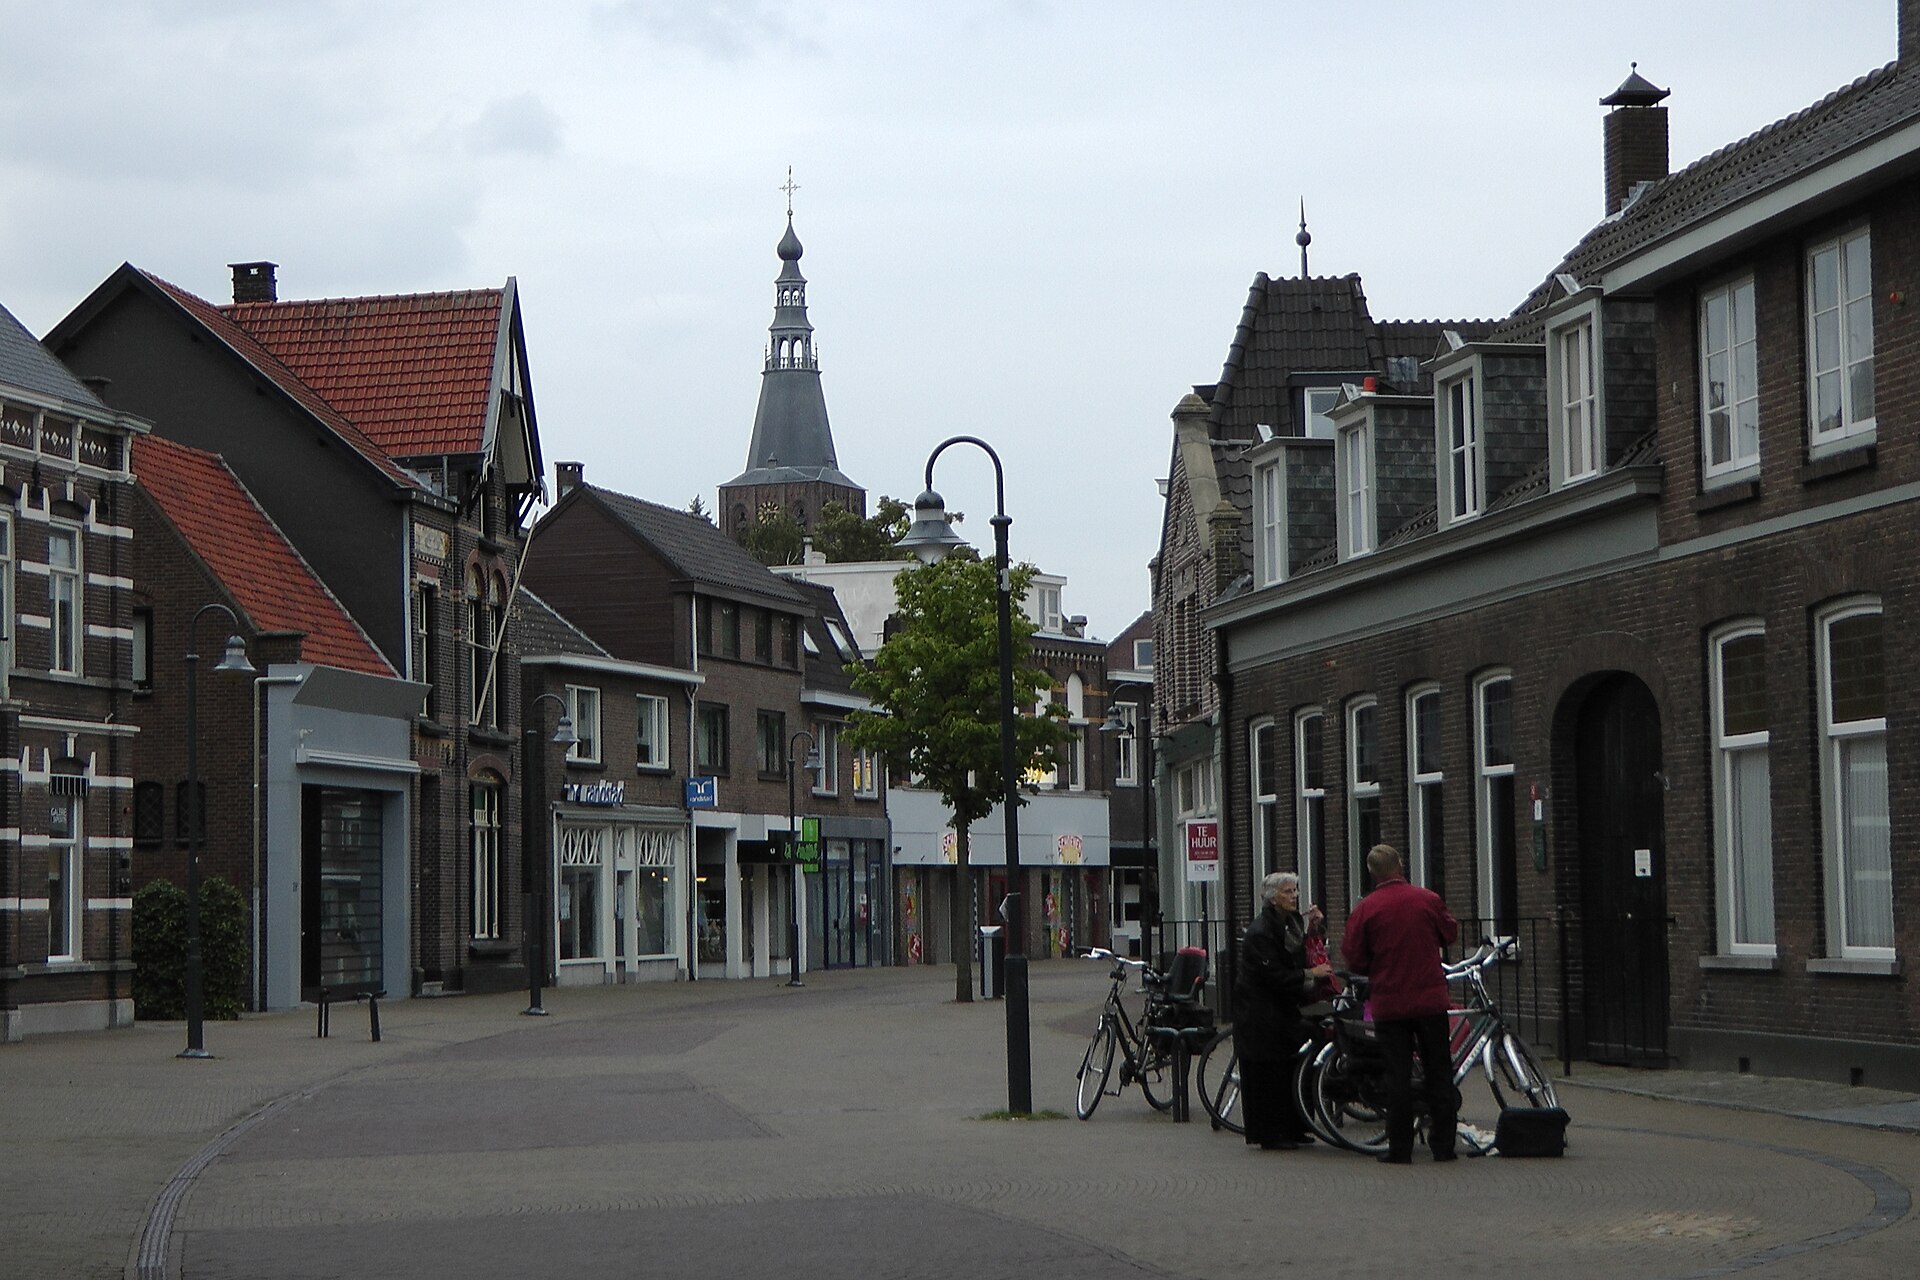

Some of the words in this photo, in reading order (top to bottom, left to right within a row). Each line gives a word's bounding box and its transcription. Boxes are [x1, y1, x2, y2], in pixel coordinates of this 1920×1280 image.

[580, 779, 624, 803] randstad
[1197, 826, 1208, 837] TE
[1191, 837, 1216, 848] HUUR
